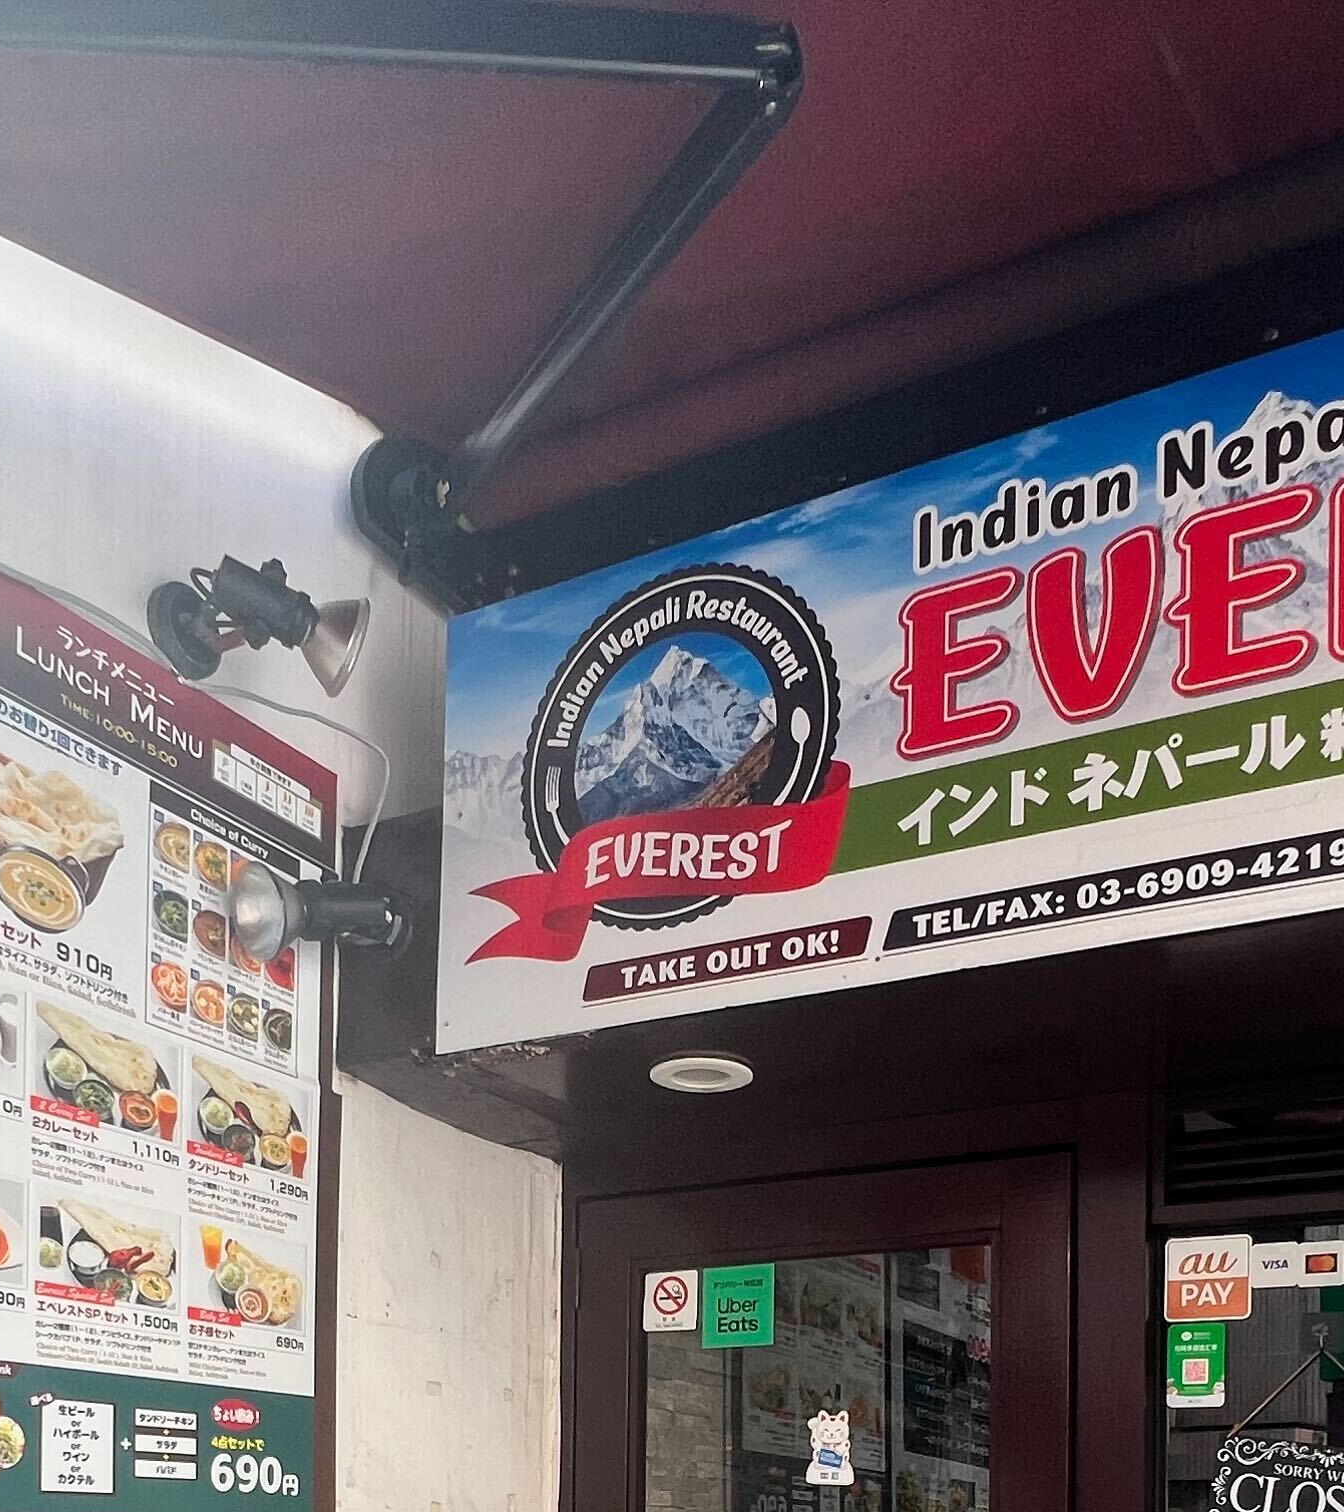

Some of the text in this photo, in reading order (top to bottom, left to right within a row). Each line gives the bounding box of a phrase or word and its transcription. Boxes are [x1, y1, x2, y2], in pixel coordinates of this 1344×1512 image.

[916, 466, 1134, 570] Indian
[57, 625, 175, 706] ランチメニュー
[547, 589, 809, 749] Indian Nepali Restaurant
[897, 766, 1048, 847] インド
[1067, 716, 1307, 812] ネパール
[584, 820, 793, 890] EVEREST
[912, 889, 1065, 938] TEL/FAX:
[56, 942, 113, 981] 910円
[621, 929, 840, 990] TAKE OUT OK!
[33, 1116, 99, 1143] 2カレーセット
[133, 1141, 179, 1166] 1,110円
[188, 1159, 250, 1183] タンドリーセット
[1178, 1249, 1238, 1275] au
[1261, 1258, 1290, 1270] VISA
[717, 1297, 759, 1314] Uber
[1180, 1281, 1235, 1307] PAY
[133, 1313, 178, 1332] 1,500円
[717, 1316, 758, 1333] Eats
[276, 1336, 304, 1352] 690円
[211, 1453, 300, 1496] 690円
[1273, 1462, 1322, 1481] SORRY
